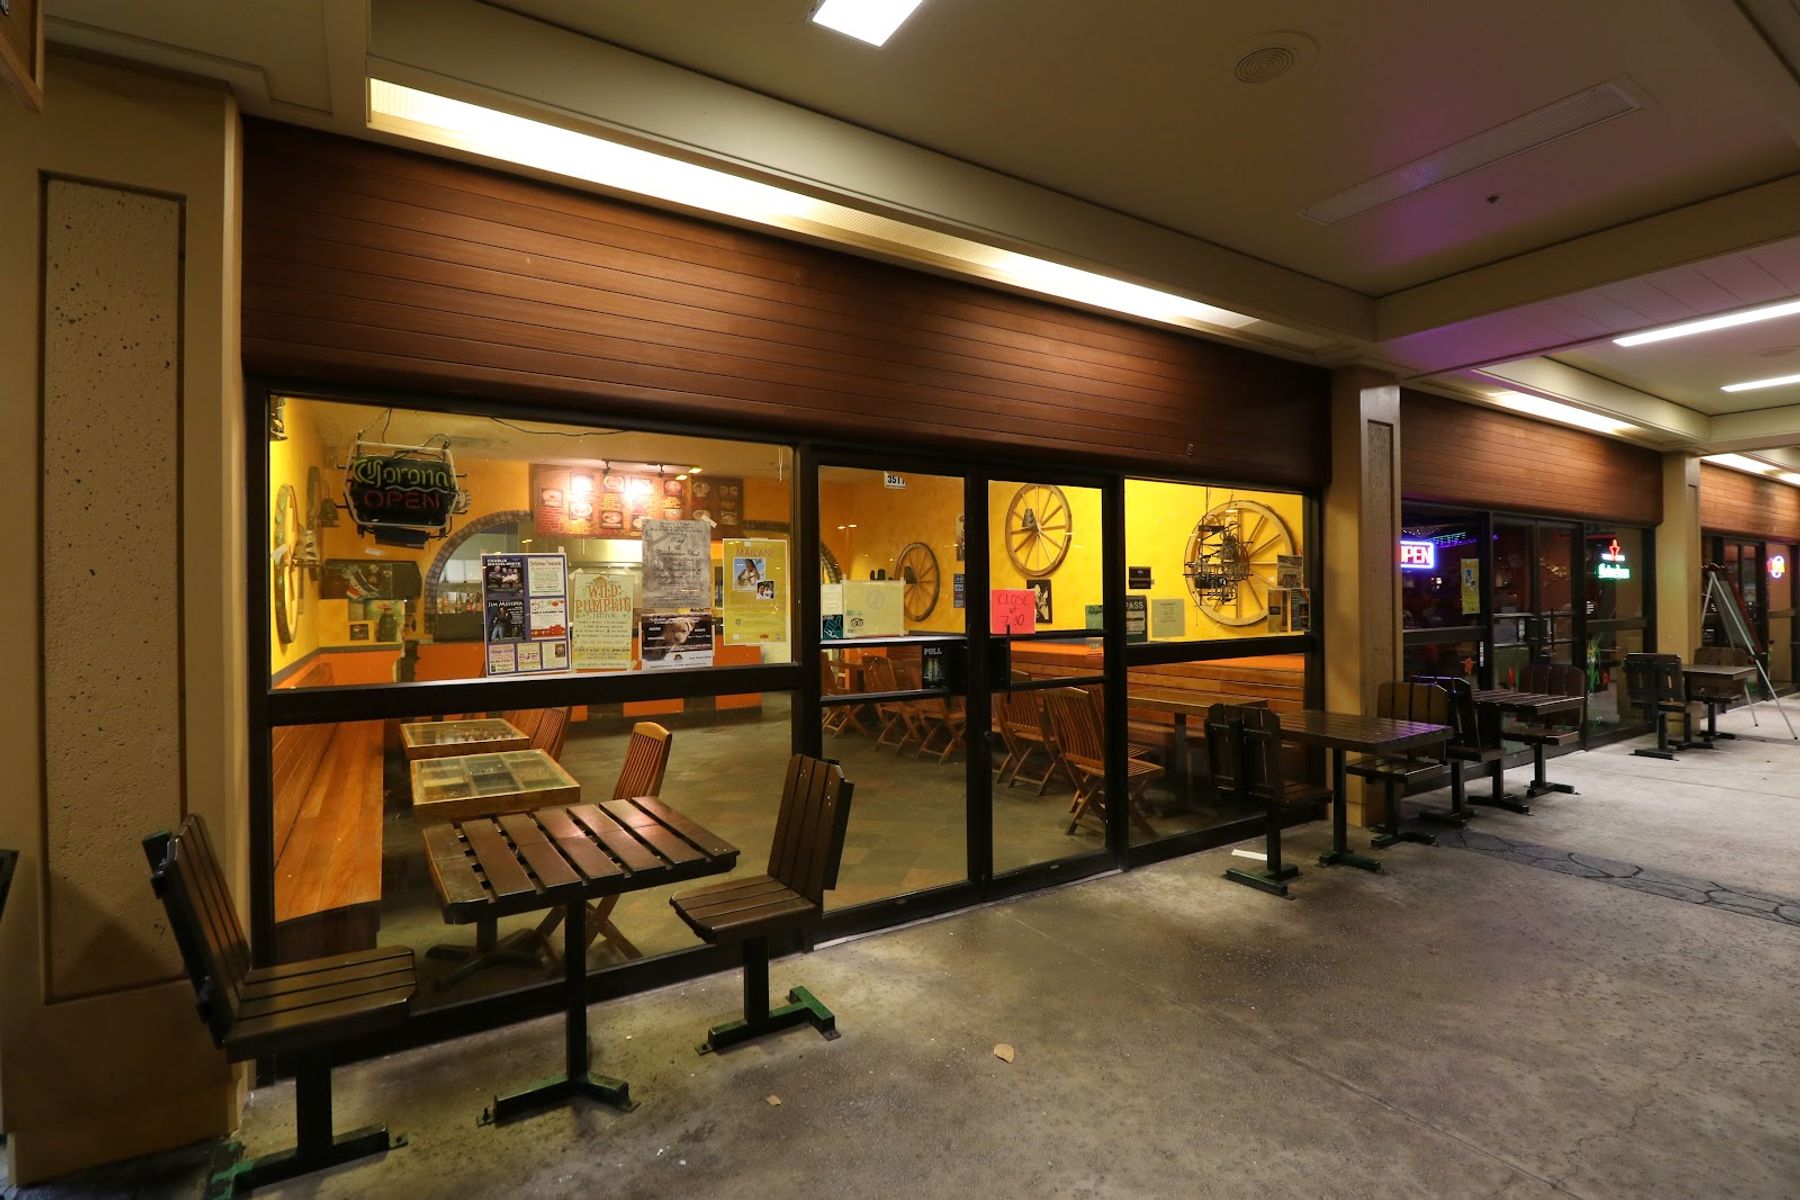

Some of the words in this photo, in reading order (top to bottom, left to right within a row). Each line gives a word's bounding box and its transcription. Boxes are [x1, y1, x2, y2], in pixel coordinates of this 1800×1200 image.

[352, 459, 448, 488] Corona
[364, 489, 440, 511] OPEN
[1400, 545, 1434, 564] PEN
[587, 583, 619, 599] WILD
[998, 591, 1030, 606] CLOSE
[575, 597, 632, 613] PUMPKIN
[923, 647, 943, 656] PULL
